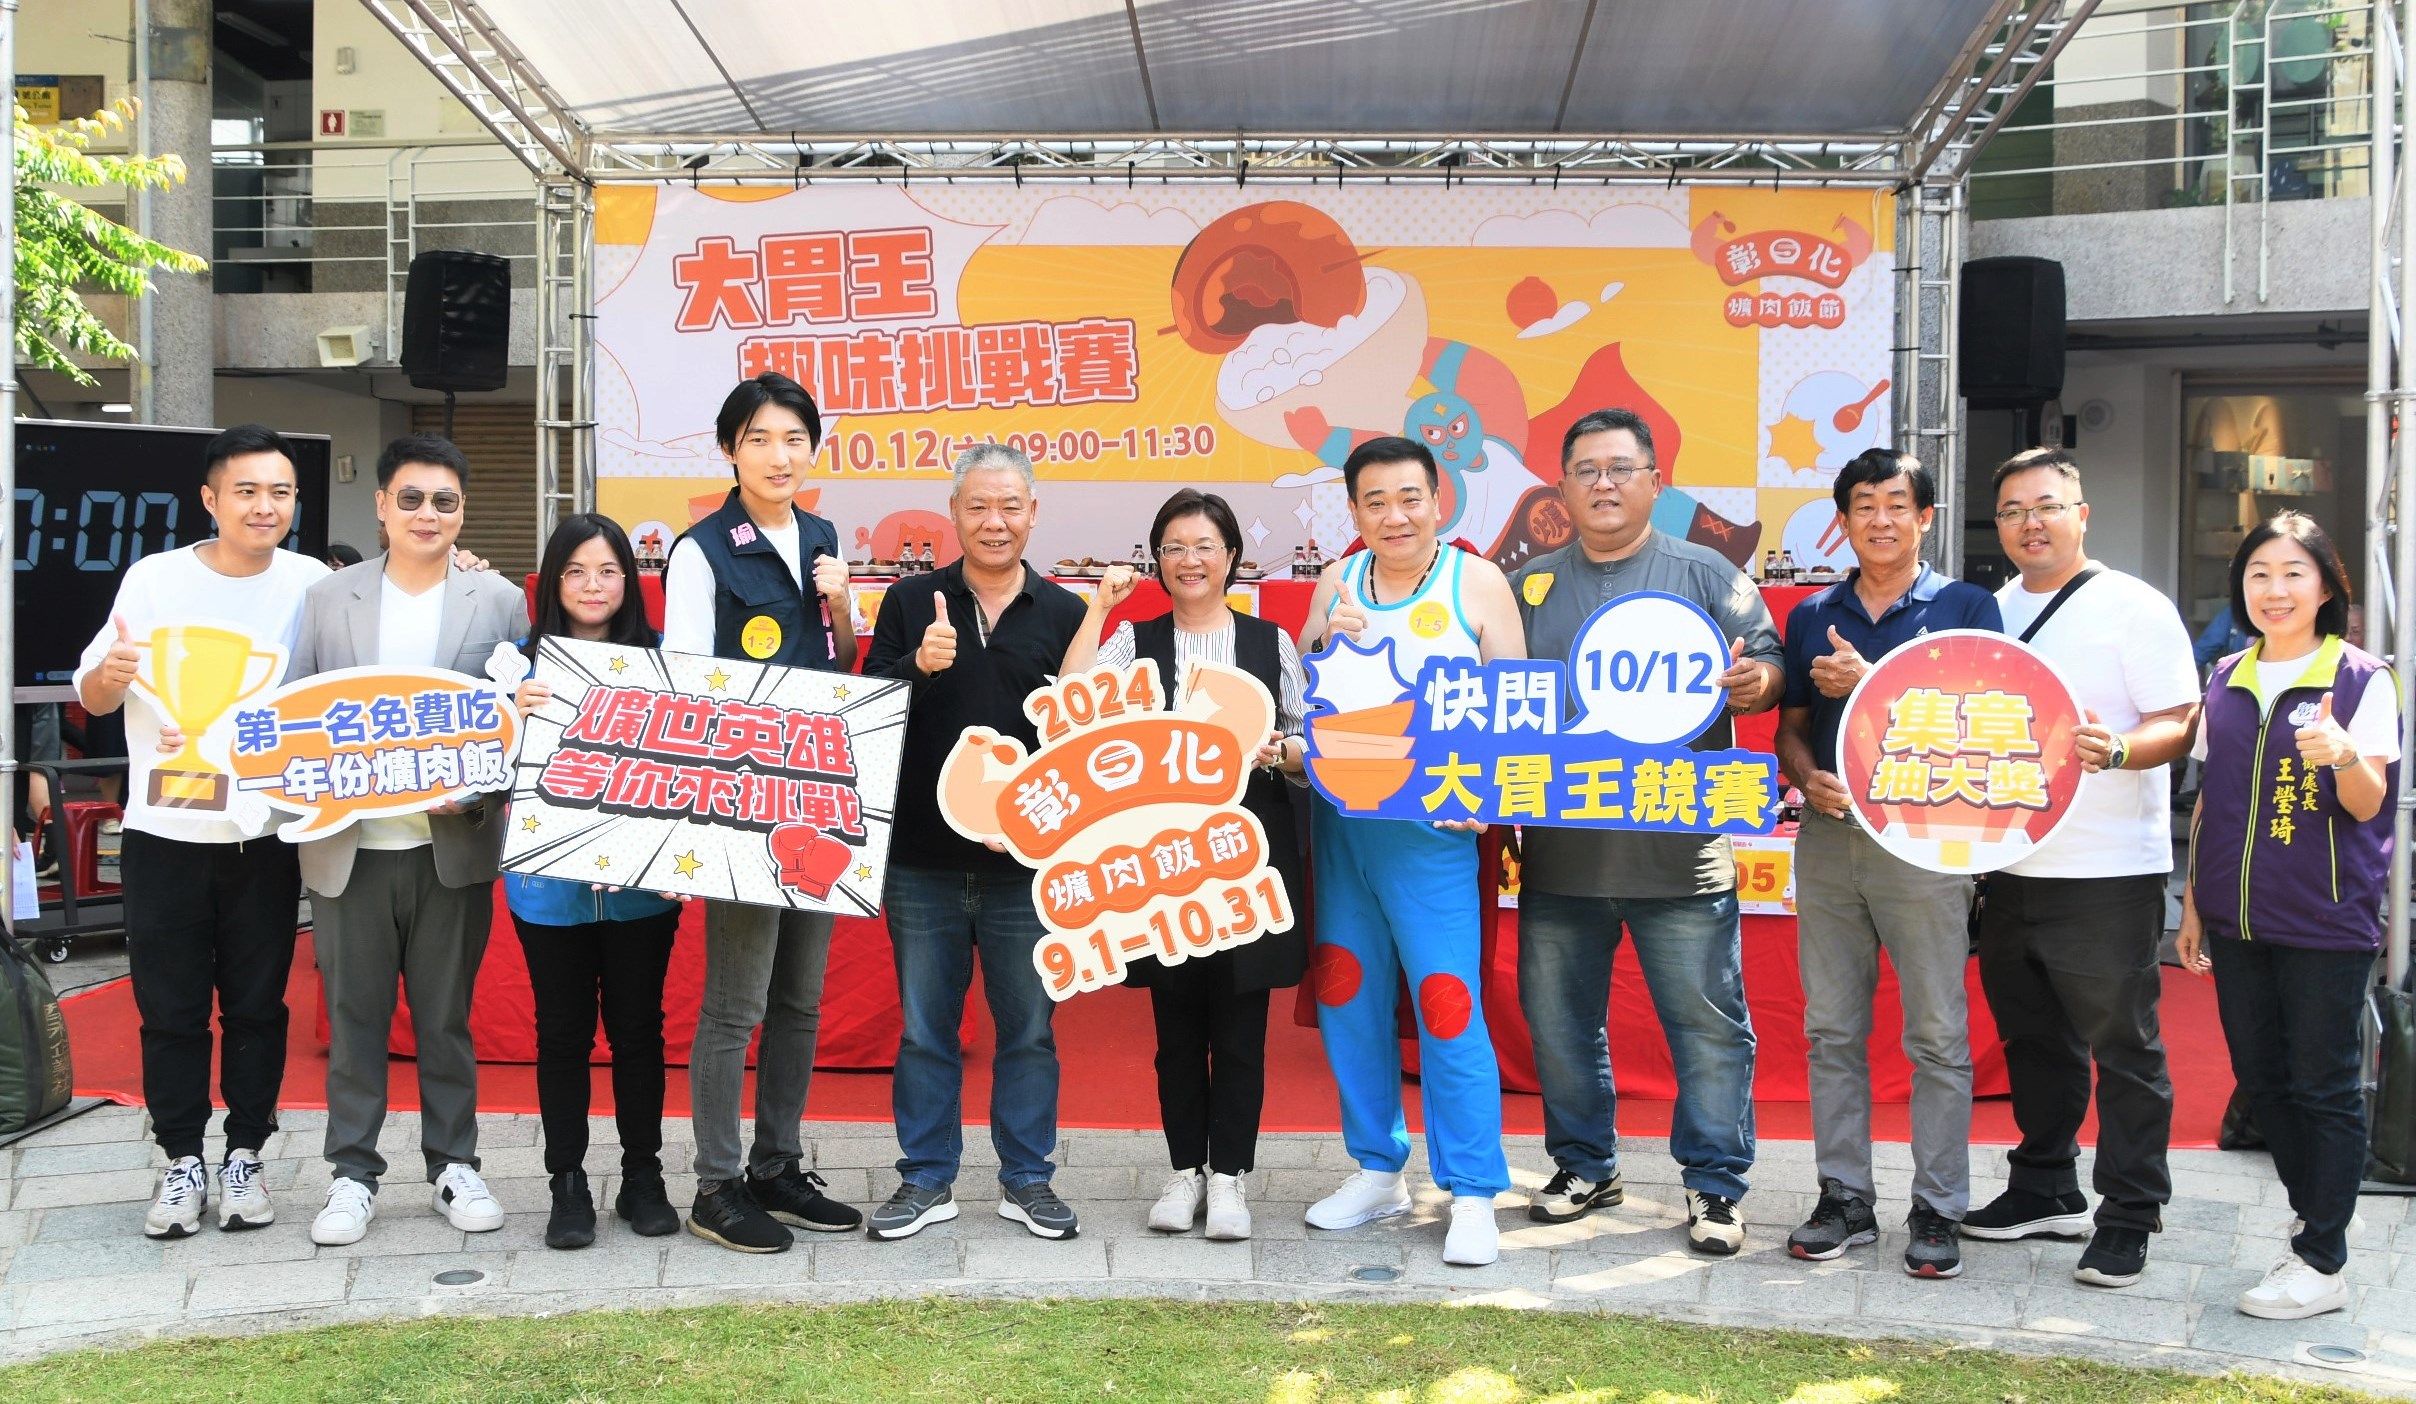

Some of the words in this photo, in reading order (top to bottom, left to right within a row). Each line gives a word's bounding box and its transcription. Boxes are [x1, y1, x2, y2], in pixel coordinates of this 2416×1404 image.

[675, 228, 936, 331] 大胃王
[1728, 297, 1840, 319] 爌肉飯節
[740, 318, 1136, 415] 趣味挑戰賽
[1032, 667, 1155, 742] 2024
[1425, 667, 1557, 736] 快閃
[1585, 649, 1714, 695] 10/12
[234, 689, 500, 753] 第一名免費吃
[563, 685, 857, 777] 爌世英雄
[1881, 688, 2041, 757] 集章
[236, 739, 507, 803] 一年份爌肉飯
[540, 749, 865, 837] 等你來挑戰
[1421, 752, 1772, 829] 大胃王競賽
[1868, 755, 2050, 809] 抽大獎
[2269, 757, 2298, 845] 王瑩琦
[1047, 820, 1250, 912] 爌肉飯節
